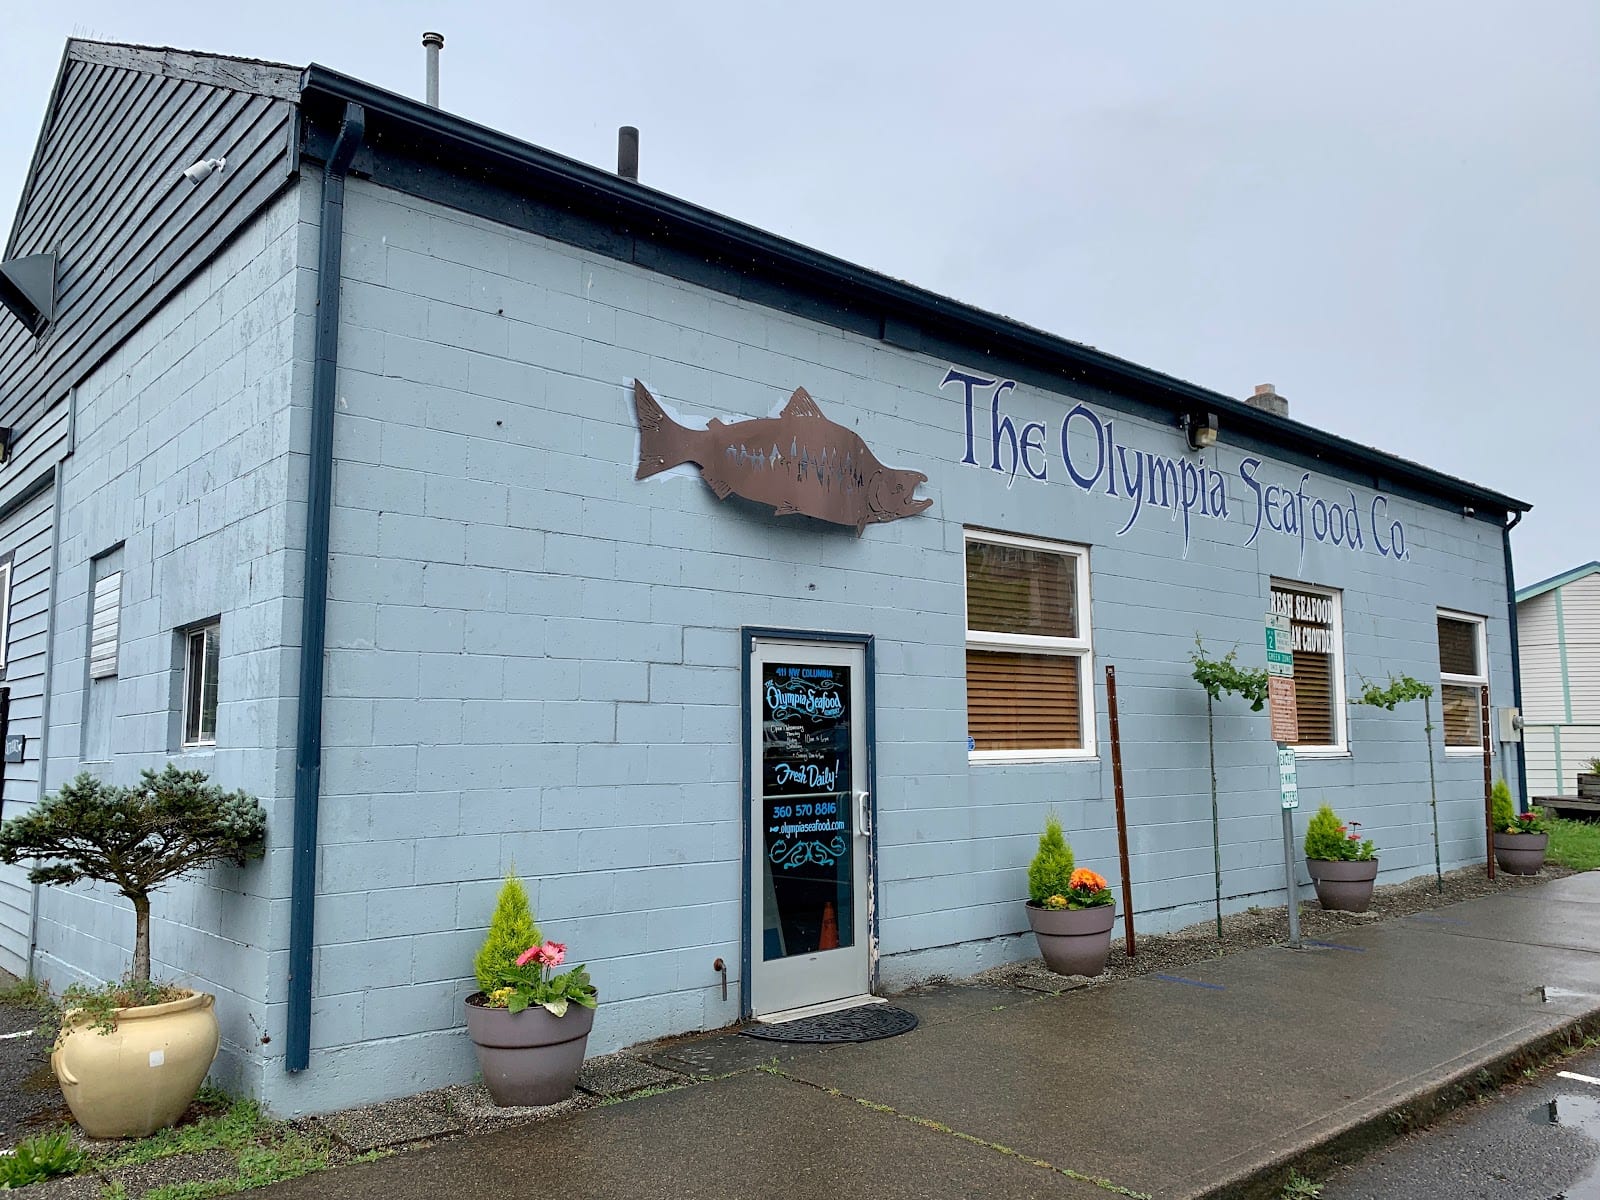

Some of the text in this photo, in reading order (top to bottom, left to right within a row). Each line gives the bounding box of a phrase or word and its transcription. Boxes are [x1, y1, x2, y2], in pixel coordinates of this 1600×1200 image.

[939, 366, 1410, 577] The Olympia Seafood Co.
[1270, 591, 1333, 624] RESH SEAFOOD
[1302, 626, 1334, 654] CHOWDER
[802, 668, 833, 678] COLUMBIA
[766, 686, 842, 713] Olympia Seafood
[774, 759, 840, 792] Fresh Daily!
[772, 802, 837, 819] 360 570 8816
